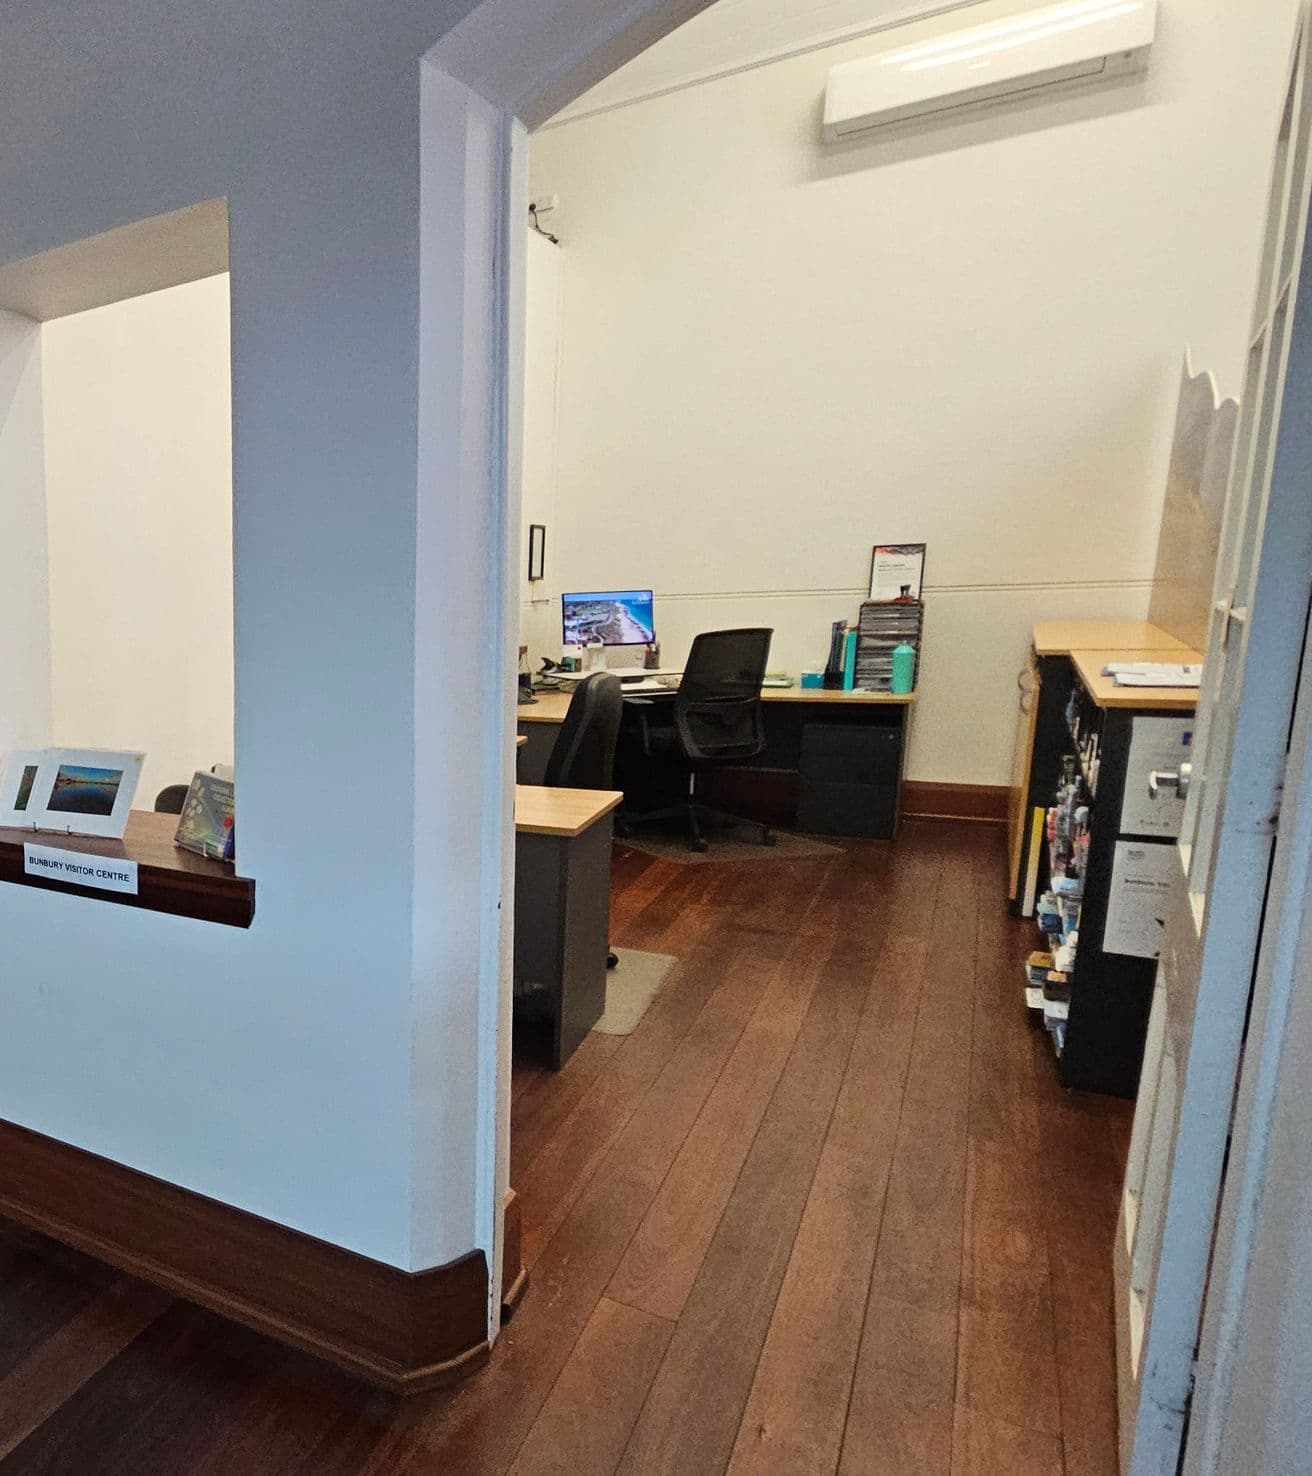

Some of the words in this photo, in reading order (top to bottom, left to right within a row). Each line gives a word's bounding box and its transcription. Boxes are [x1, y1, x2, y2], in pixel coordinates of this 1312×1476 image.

[28, 856, 64, 871] BUNBURY
[65, 862, 94, 876] VISITOR
[96, 868, 130, 882] CENTRE
